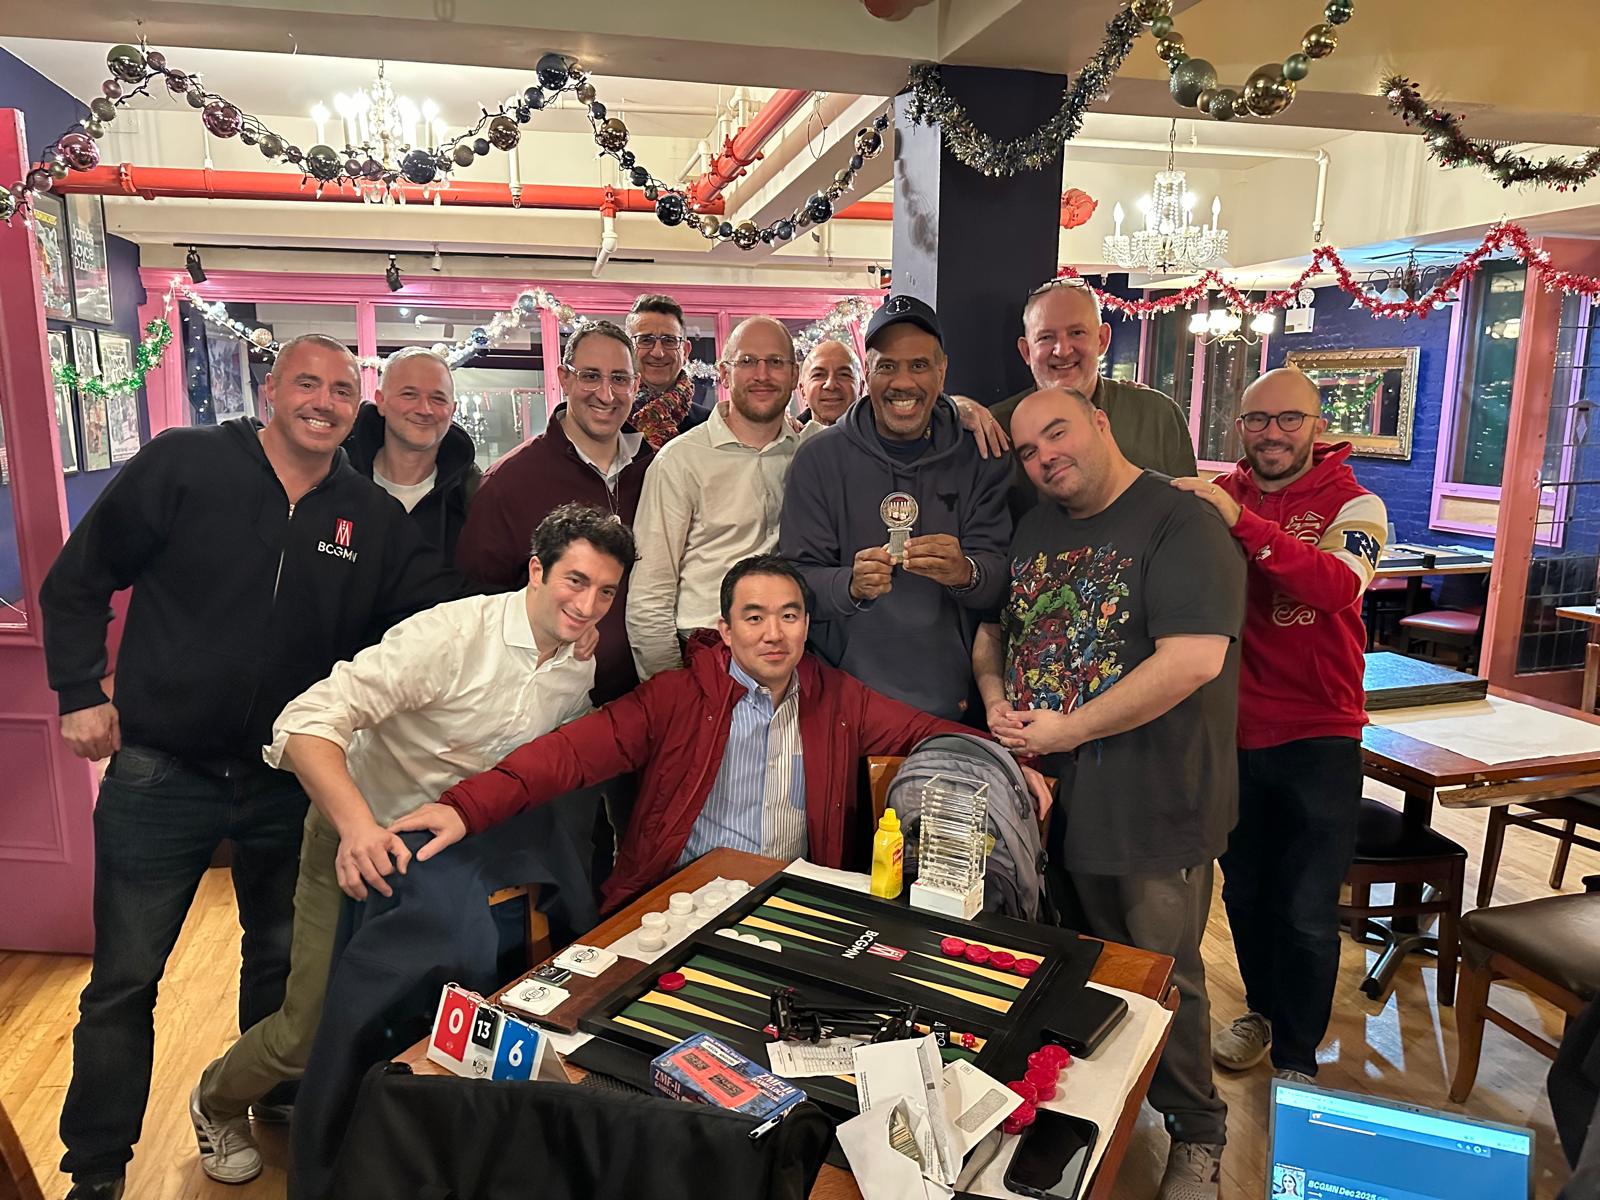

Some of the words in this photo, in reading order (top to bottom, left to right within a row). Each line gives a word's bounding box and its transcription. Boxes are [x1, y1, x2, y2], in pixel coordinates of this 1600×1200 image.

[72, 223, 95, 246] James
[73, 240, 95, 261] Joyce
[317, 540, 358, 563] BCGMN
[1341, 528, 1382, 571] N
[841, 929, 880, 960] BCGMN
[448, 1007, 464, 1034] 0
[476, 1020, 492, 1039] 13
[508, 1039, 525, 1067] 6
[1308, 1180, 1339, 1194] BCGMN
[1339, 1187, 1355, 1198] Dec
